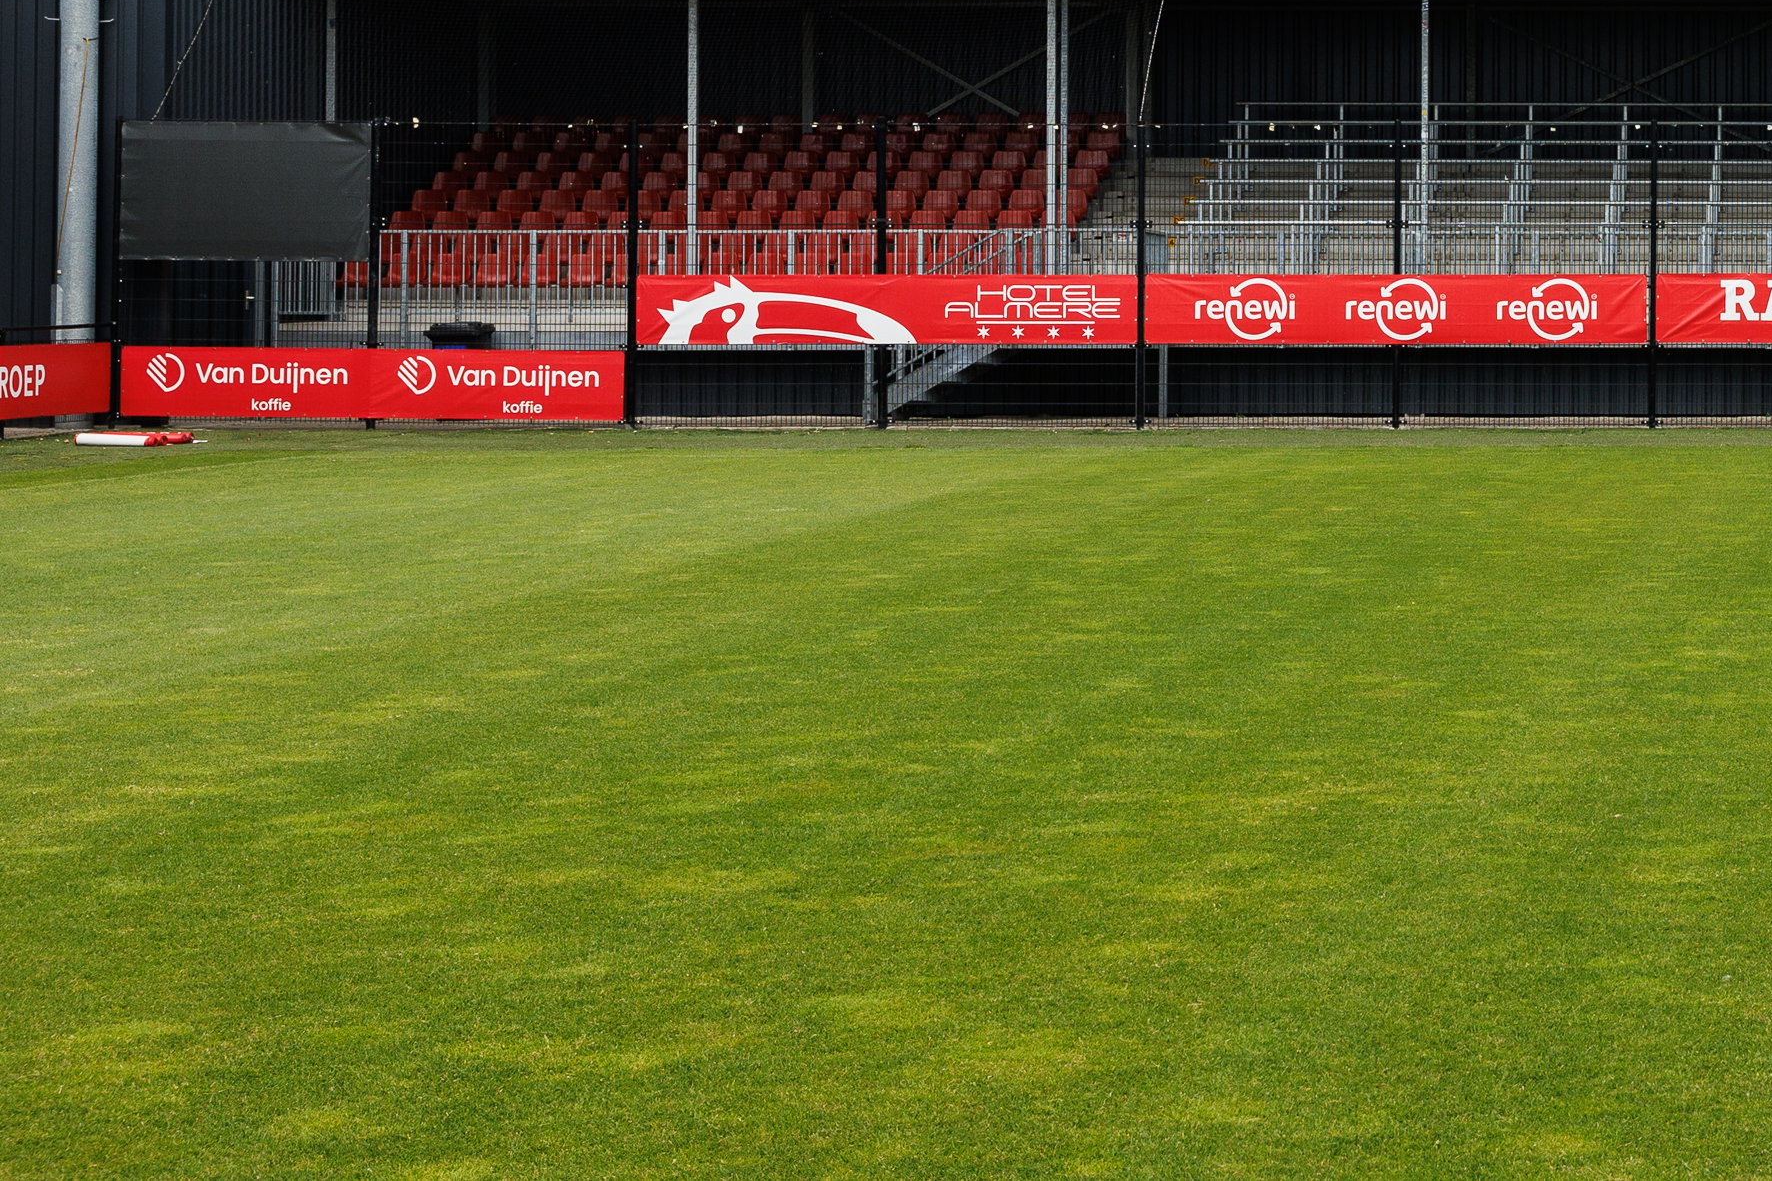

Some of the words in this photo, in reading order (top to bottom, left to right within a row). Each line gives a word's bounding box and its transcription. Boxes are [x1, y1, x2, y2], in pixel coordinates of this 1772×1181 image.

[976, 284, 1121, 302] HOTEL
[1194, 292, 1296, 322] renewi
[1345, 292, 1447, 322] renewi
[1496, 292, 1598, 322] renewi
[944, 301, 1121, 319] ALMERE
[195, 362, 245, 384] Van
[251, 362, 348, 394] Duijnen
[446, 365, 496, 387] Van
[502, 364, 600, 397] Duijnen
[251, 397, 292, 412] koffie
[502, 400, 543, 414] koffie
